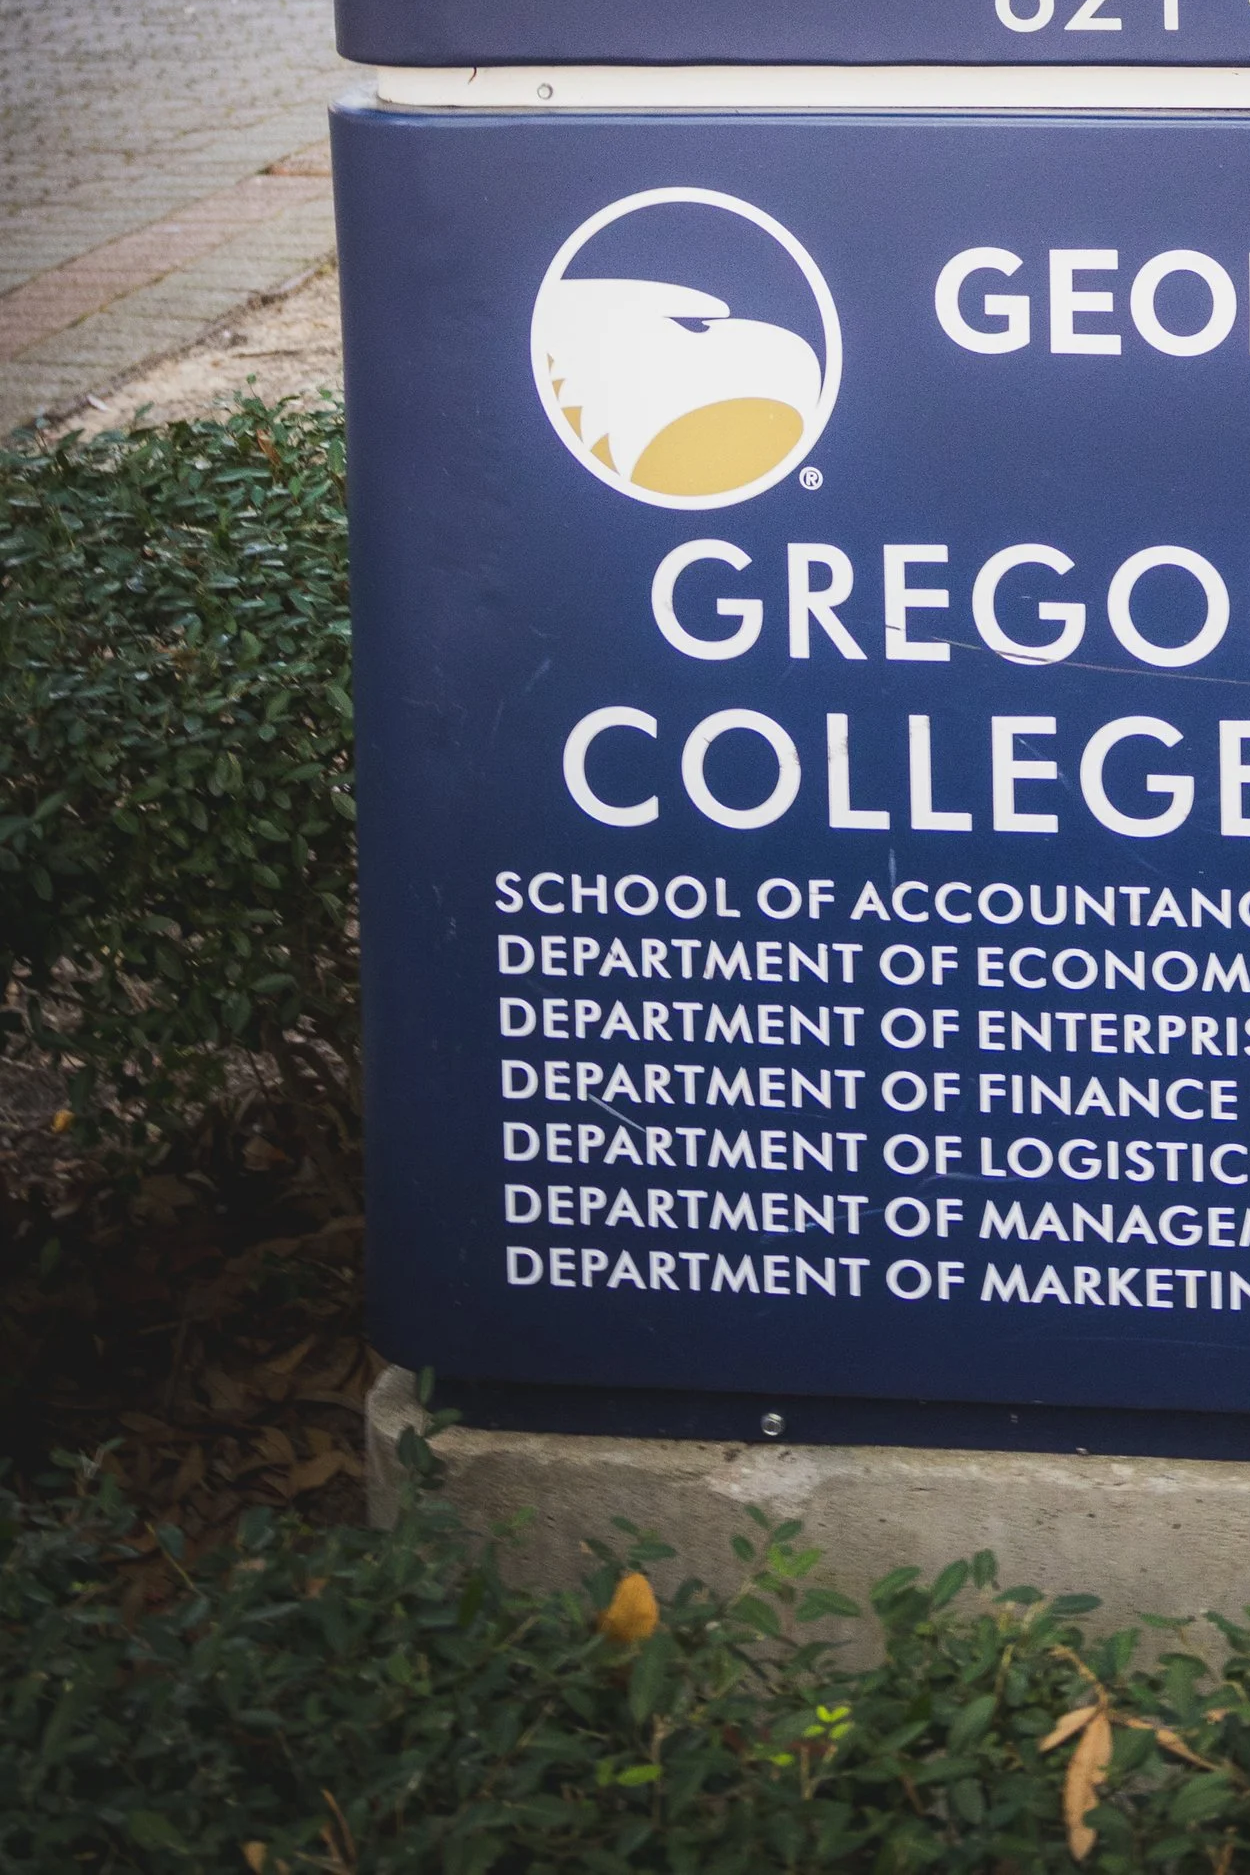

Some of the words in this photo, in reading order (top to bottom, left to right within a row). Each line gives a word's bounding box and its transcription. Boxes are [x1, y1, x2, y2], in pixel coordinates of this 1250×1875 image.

[495, 871, 741, 919] SCHOOL
[756, 877, 835, 920] OF
[497, 934, 864, 984] DEPARTMENT
[879, 944, 959, 986] OF
[499, 997, 865, 1047] DEPARTMENT
[880, 1007, 960, 1049] OF
[501, 1059, 866, 1110] DEPARTMENT
[881, 1070, 961, 1112] OF
[979, 1073, 1238, 1121] FINANCE
[503, 1121, 868, 1172] DEPARTMENT
[883, 1133, 962, 1175] OF
[504, 1184, 869, 1235] DEPARTMENT
[884, 1196, 964, 1238] OF
[506, 1246, 871, 1297] DEPARTMENT
[885, 1259, 965, 1300] OF
